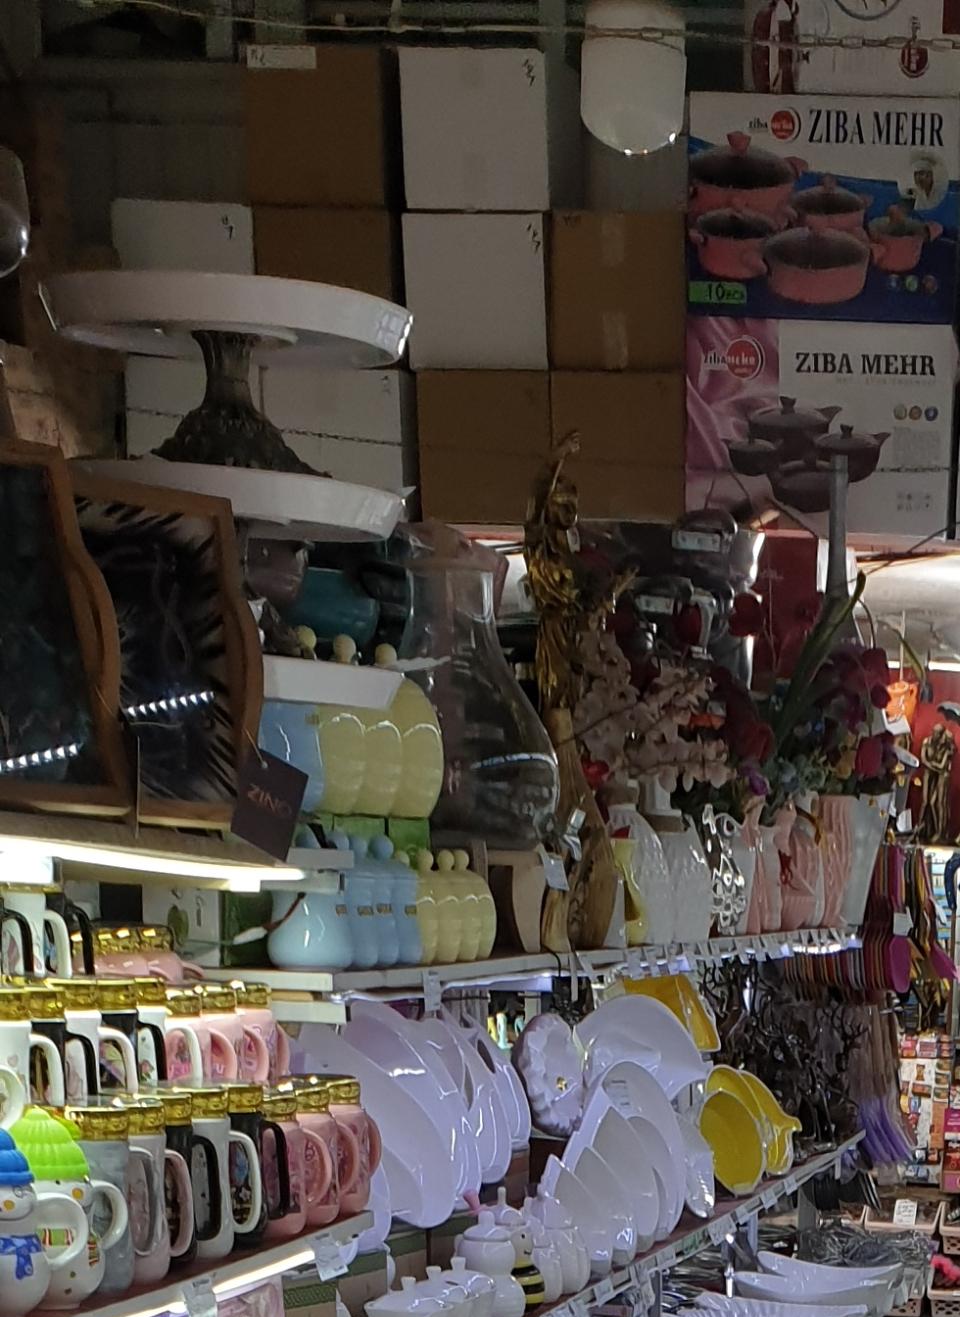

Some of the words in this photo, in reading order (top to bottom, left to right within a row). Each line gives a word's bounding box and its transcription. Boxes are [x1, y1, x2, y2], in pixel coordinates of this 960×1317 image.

[808, 108, 865, 145] ZIBA
[872, 110, 944, 147] MEHR
[795, 352, 852, 375] ZIBA
[861, 354, 936, 377] MEHR
